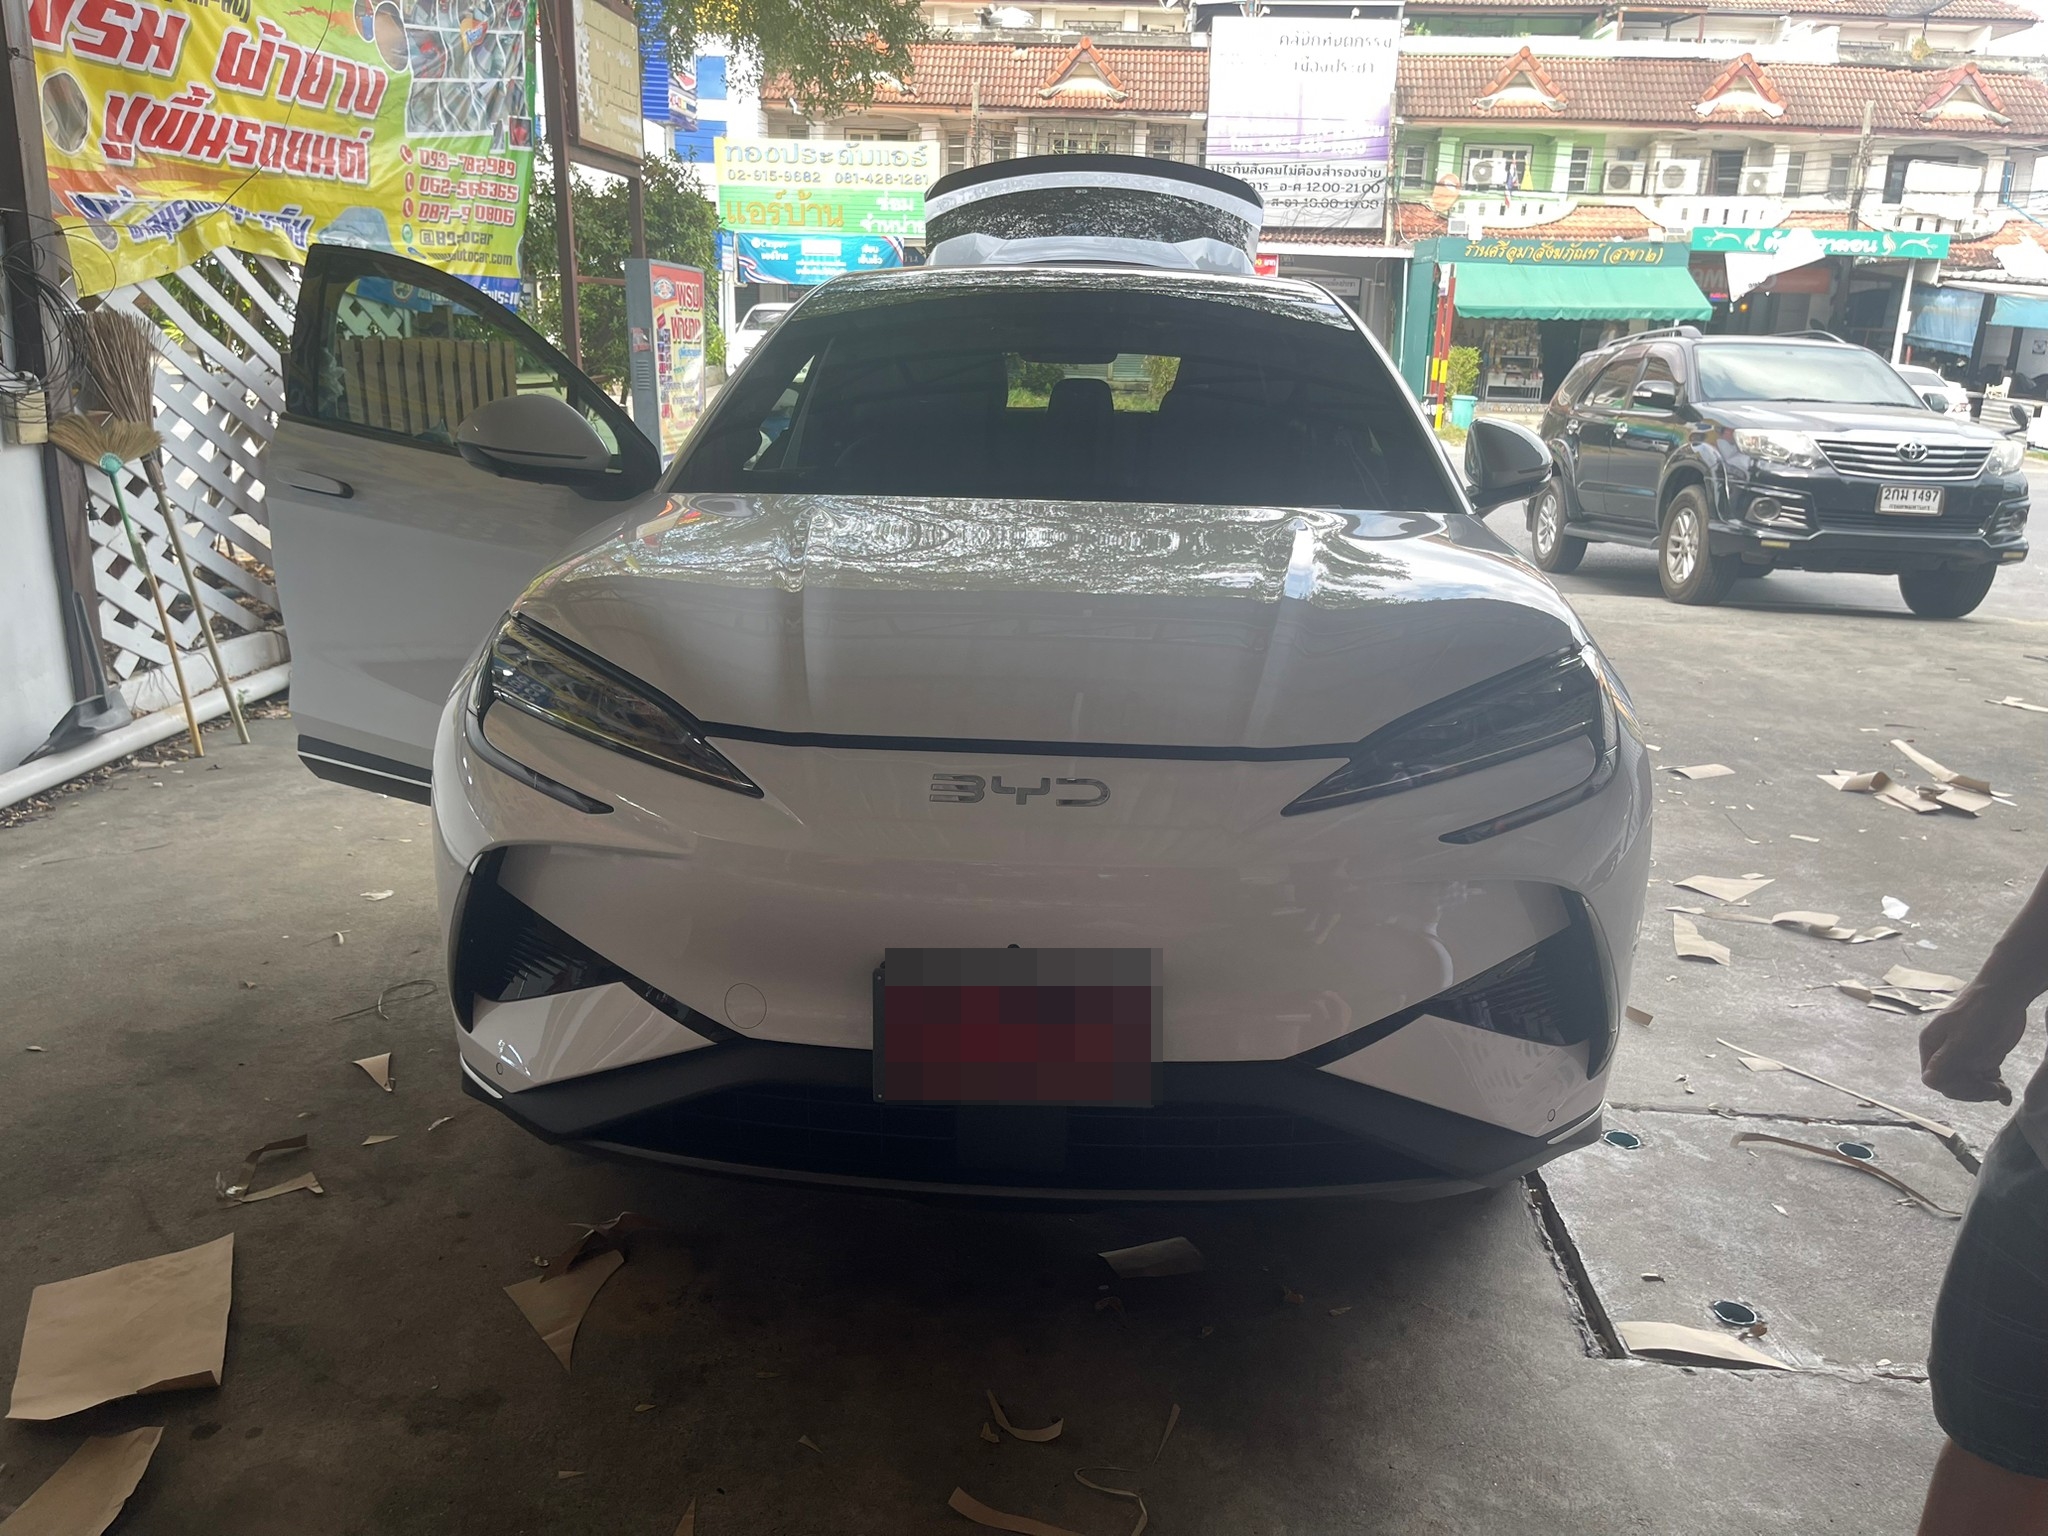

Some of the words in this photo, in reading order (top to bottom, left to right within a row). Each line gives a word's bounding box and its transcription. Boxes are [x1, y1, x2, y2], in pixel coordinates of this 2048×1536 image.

[213, 20, 387, 119] ผ้ายาง
[101, 84, 375, 184] ปูพื้นรถยนต์
[725, 188, 845, 228] แอร์บ้าน
[1884, 488, 1909, 502] 2กม
[1912, 489, 1939, 503] 1497
[929, 773, 1111, 807] BYD
